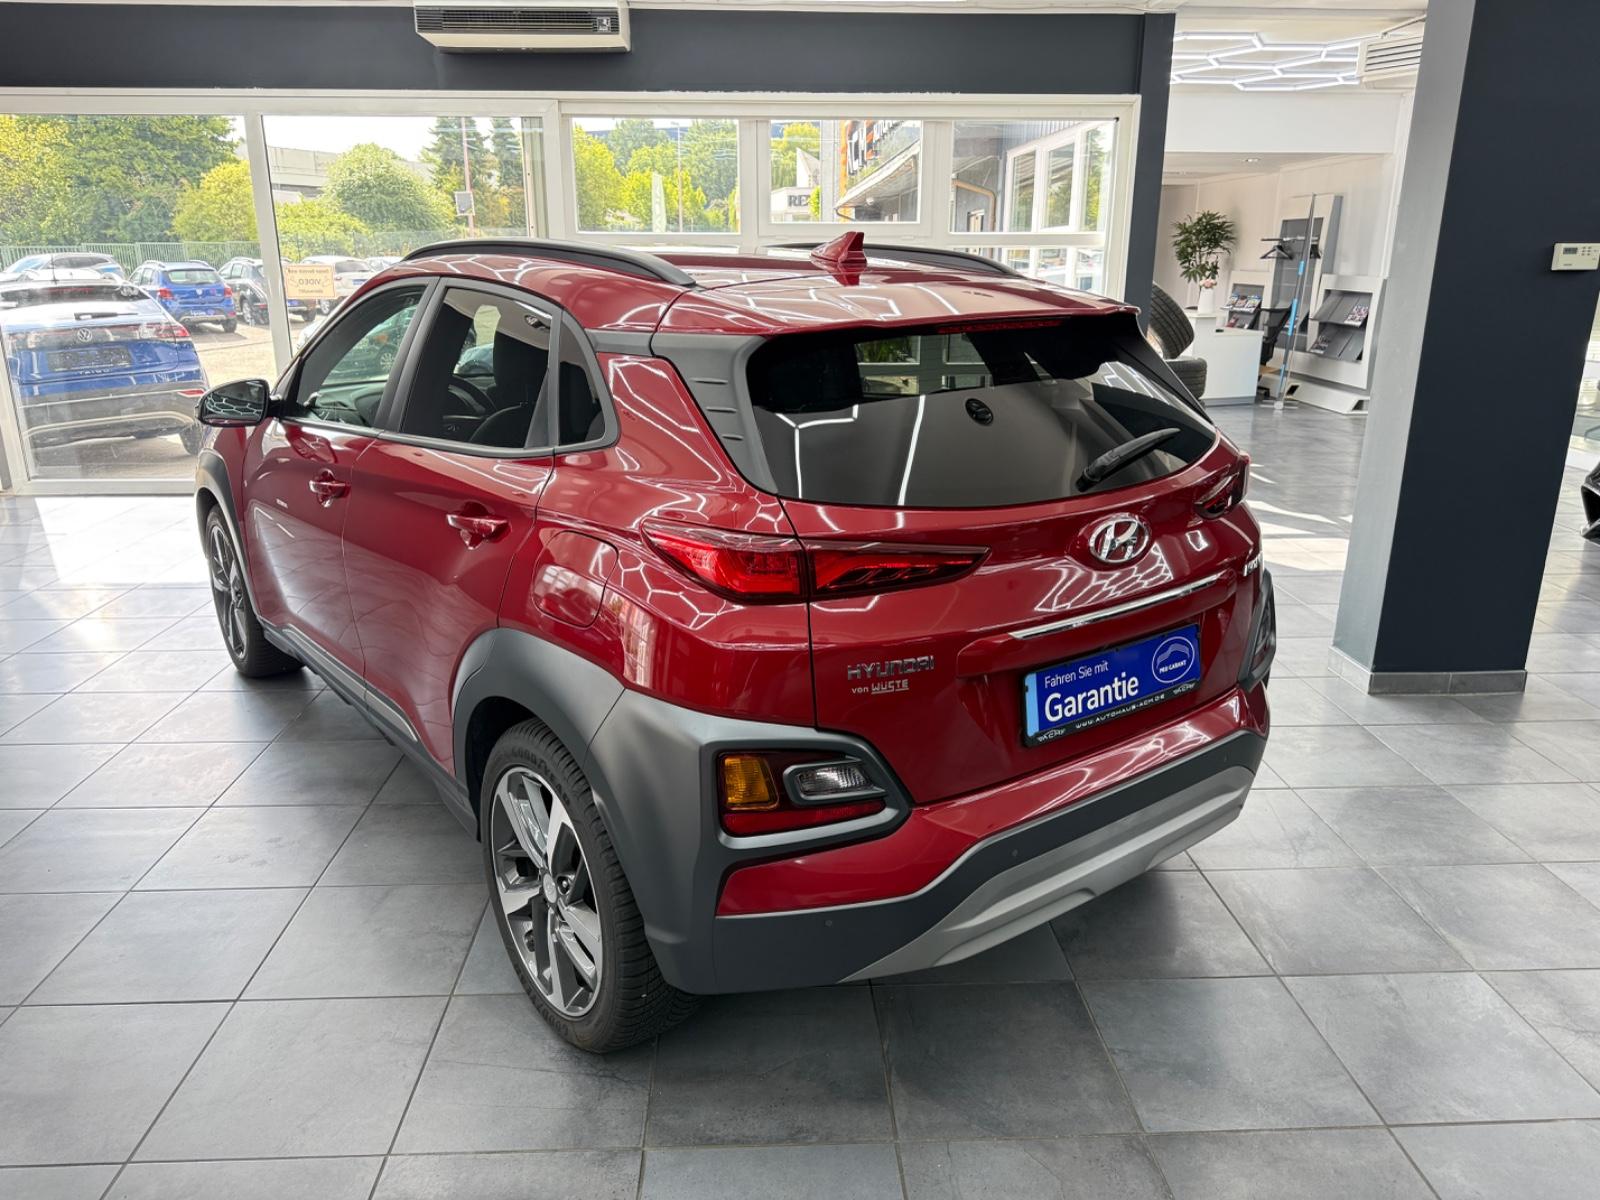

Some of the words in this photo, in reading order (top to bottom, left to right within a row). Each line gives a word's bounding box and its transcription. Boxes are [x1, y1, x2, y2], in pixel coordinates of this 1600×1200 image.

[847, 655, 934, 681] HYUNDAI
[1044, 671, 1077, 689] Fahren
[1078, 665, 1093, 680] Sie
[1094, 660, 1110, 675] mit
[851, 686, 869, 694] von
[1045, 673, 1139, 722] Garantie
